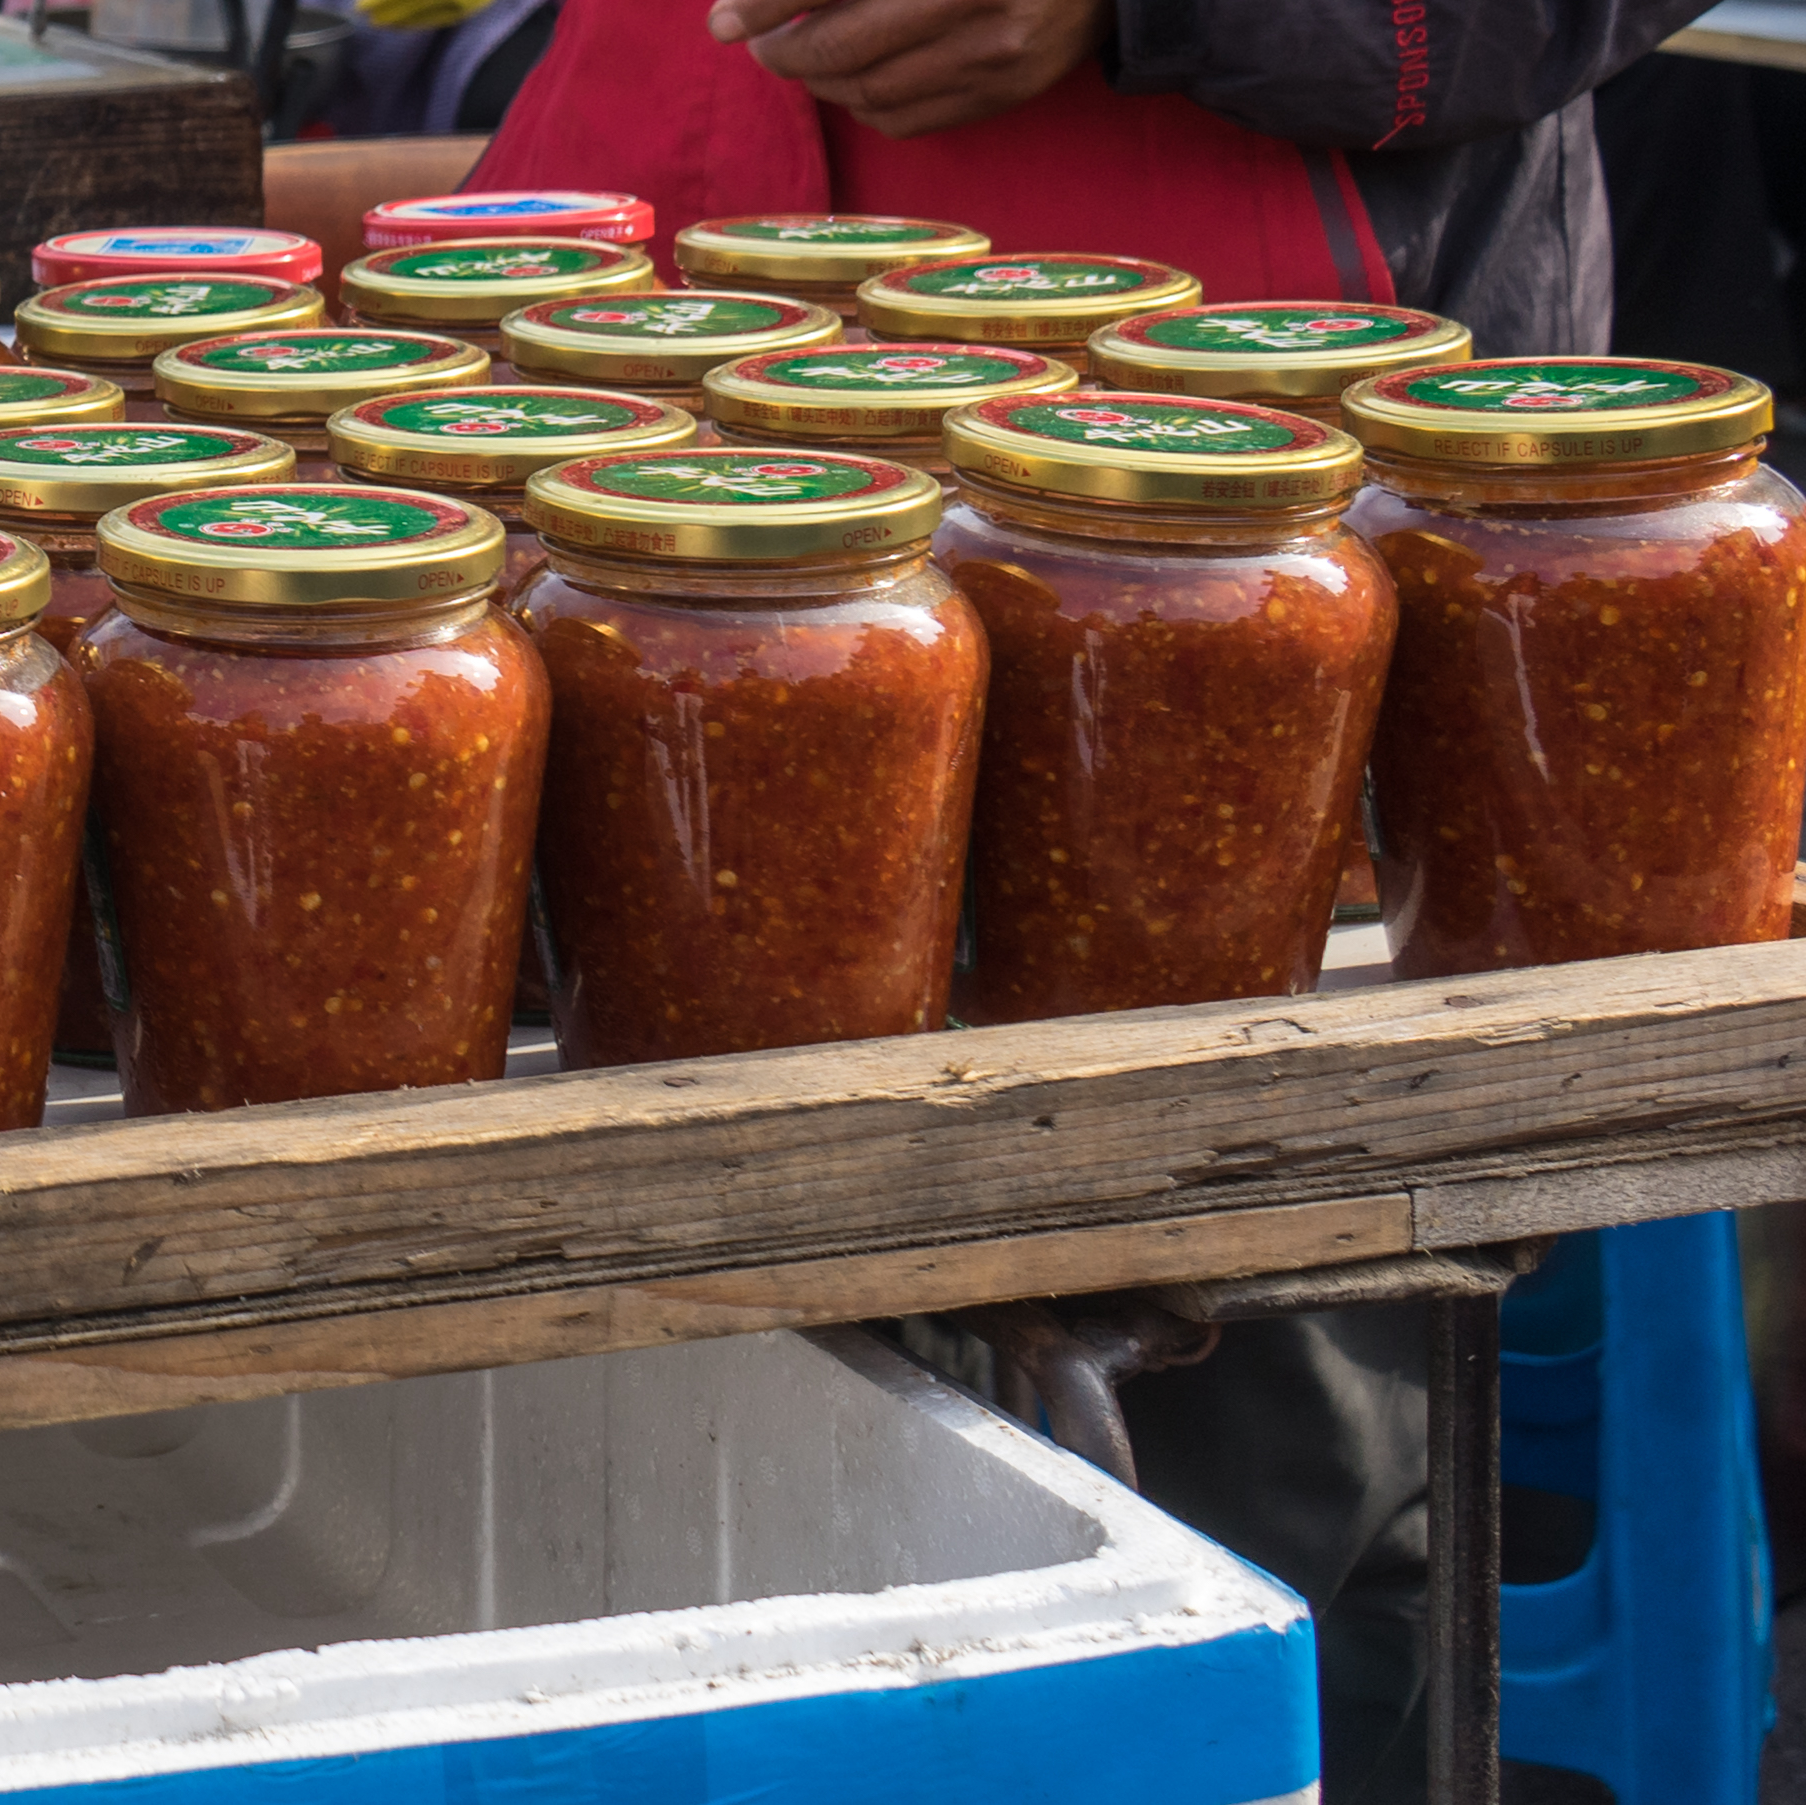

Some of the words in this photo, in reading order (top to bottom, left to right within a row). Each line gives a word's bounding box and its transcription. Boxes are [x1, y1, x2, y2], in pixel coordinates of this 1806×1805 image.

[624, 363, 666, 380] OPEN
[194, 393, 227, 411] OPEN
[1434, 438, 1490, 458] REJECT
[1496, 440, 1510, 457] IF
[1517, 440, 1594, 458] CAPSULE
[1600, 439, 1616, 454] IS
[1621, 438, 1643, 454] UP
[353, 450, 390, 471] REJECT
[395, 458, 405, 473] IF
[410, 459, 472, 479] CAPSULE
[476, 463, 490, 479] IS
[495, 465, 515, 480] UP
[983, 453, 1020, 478] OPEN
[842, 525, 883, 549] OPEN
[132, 563, 184, 590] CAPSULE
[188, 573, 202, 590] IS
[205, 576, 226, 594] UP
[417, 571, 455, 590] OPEN
[4, 597, 21, 618] UP
